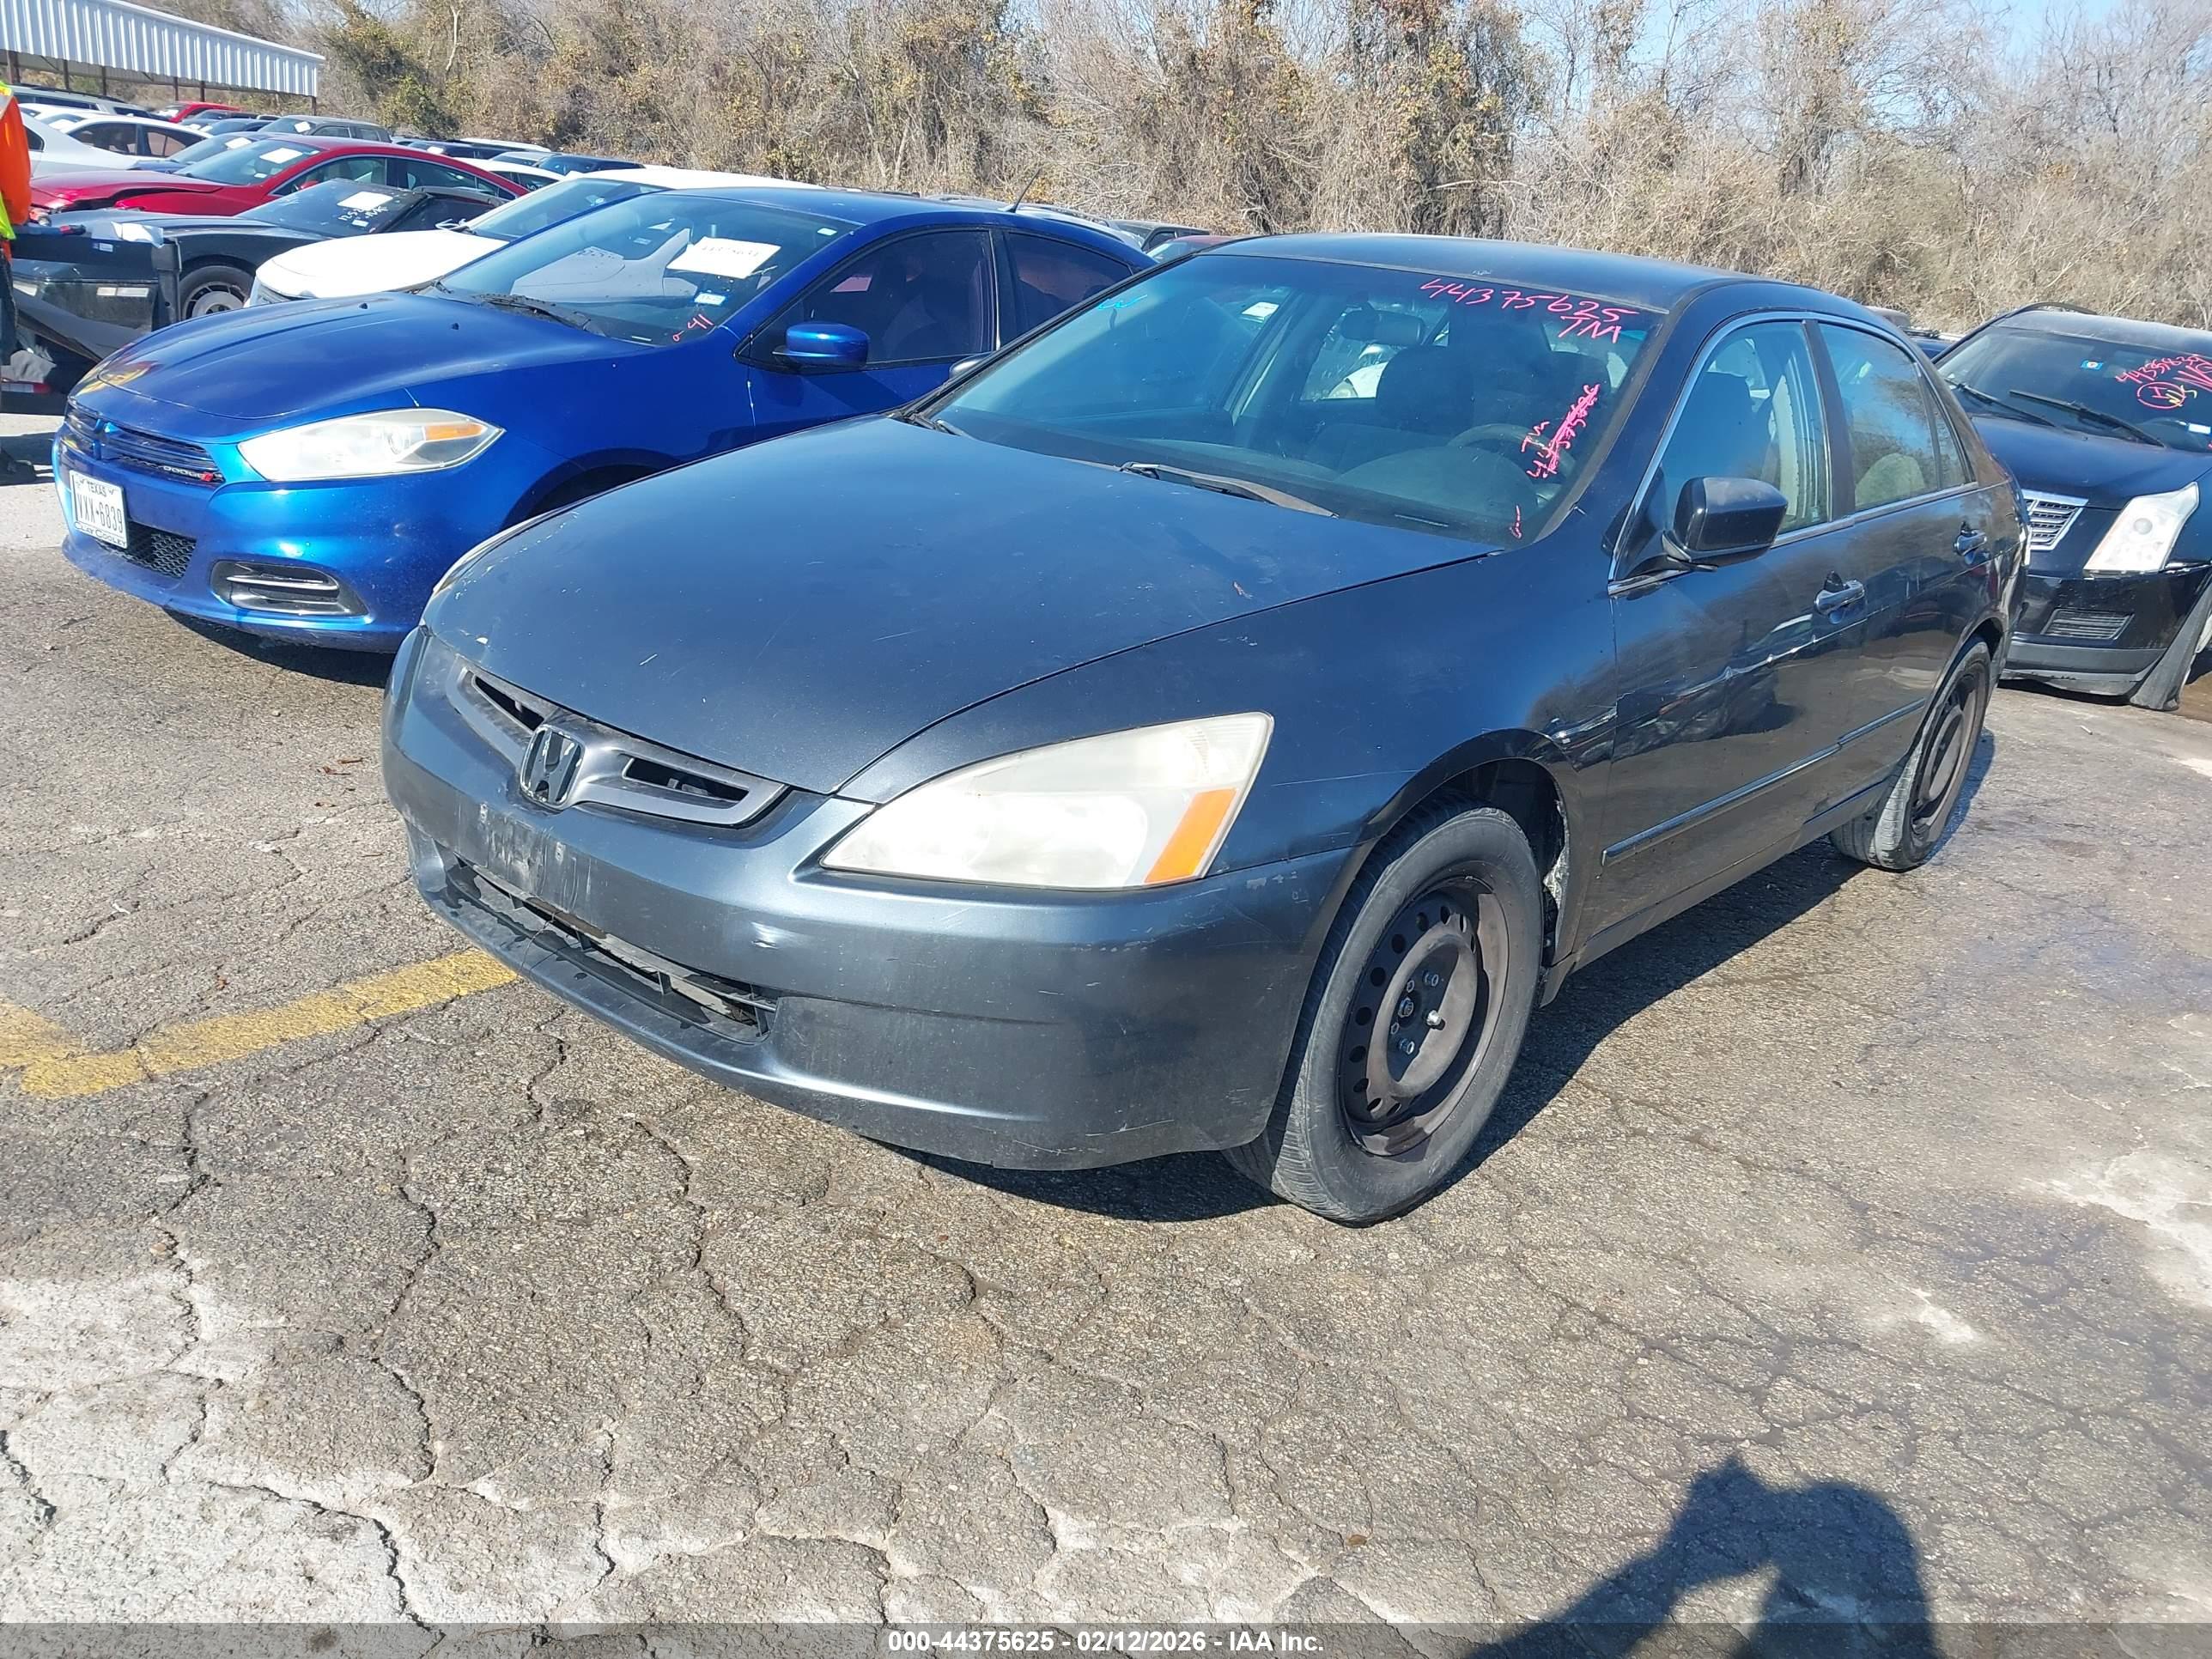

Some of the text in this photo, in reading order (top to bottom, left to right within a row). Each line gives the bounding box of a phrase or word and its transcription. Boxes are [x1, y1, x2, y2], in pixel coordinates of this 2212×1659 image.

[1419, 277, 1640, 323] 44375625
[1559, 315, 1622, 344] TM
[86, 481, 107, 497] TEXAS
